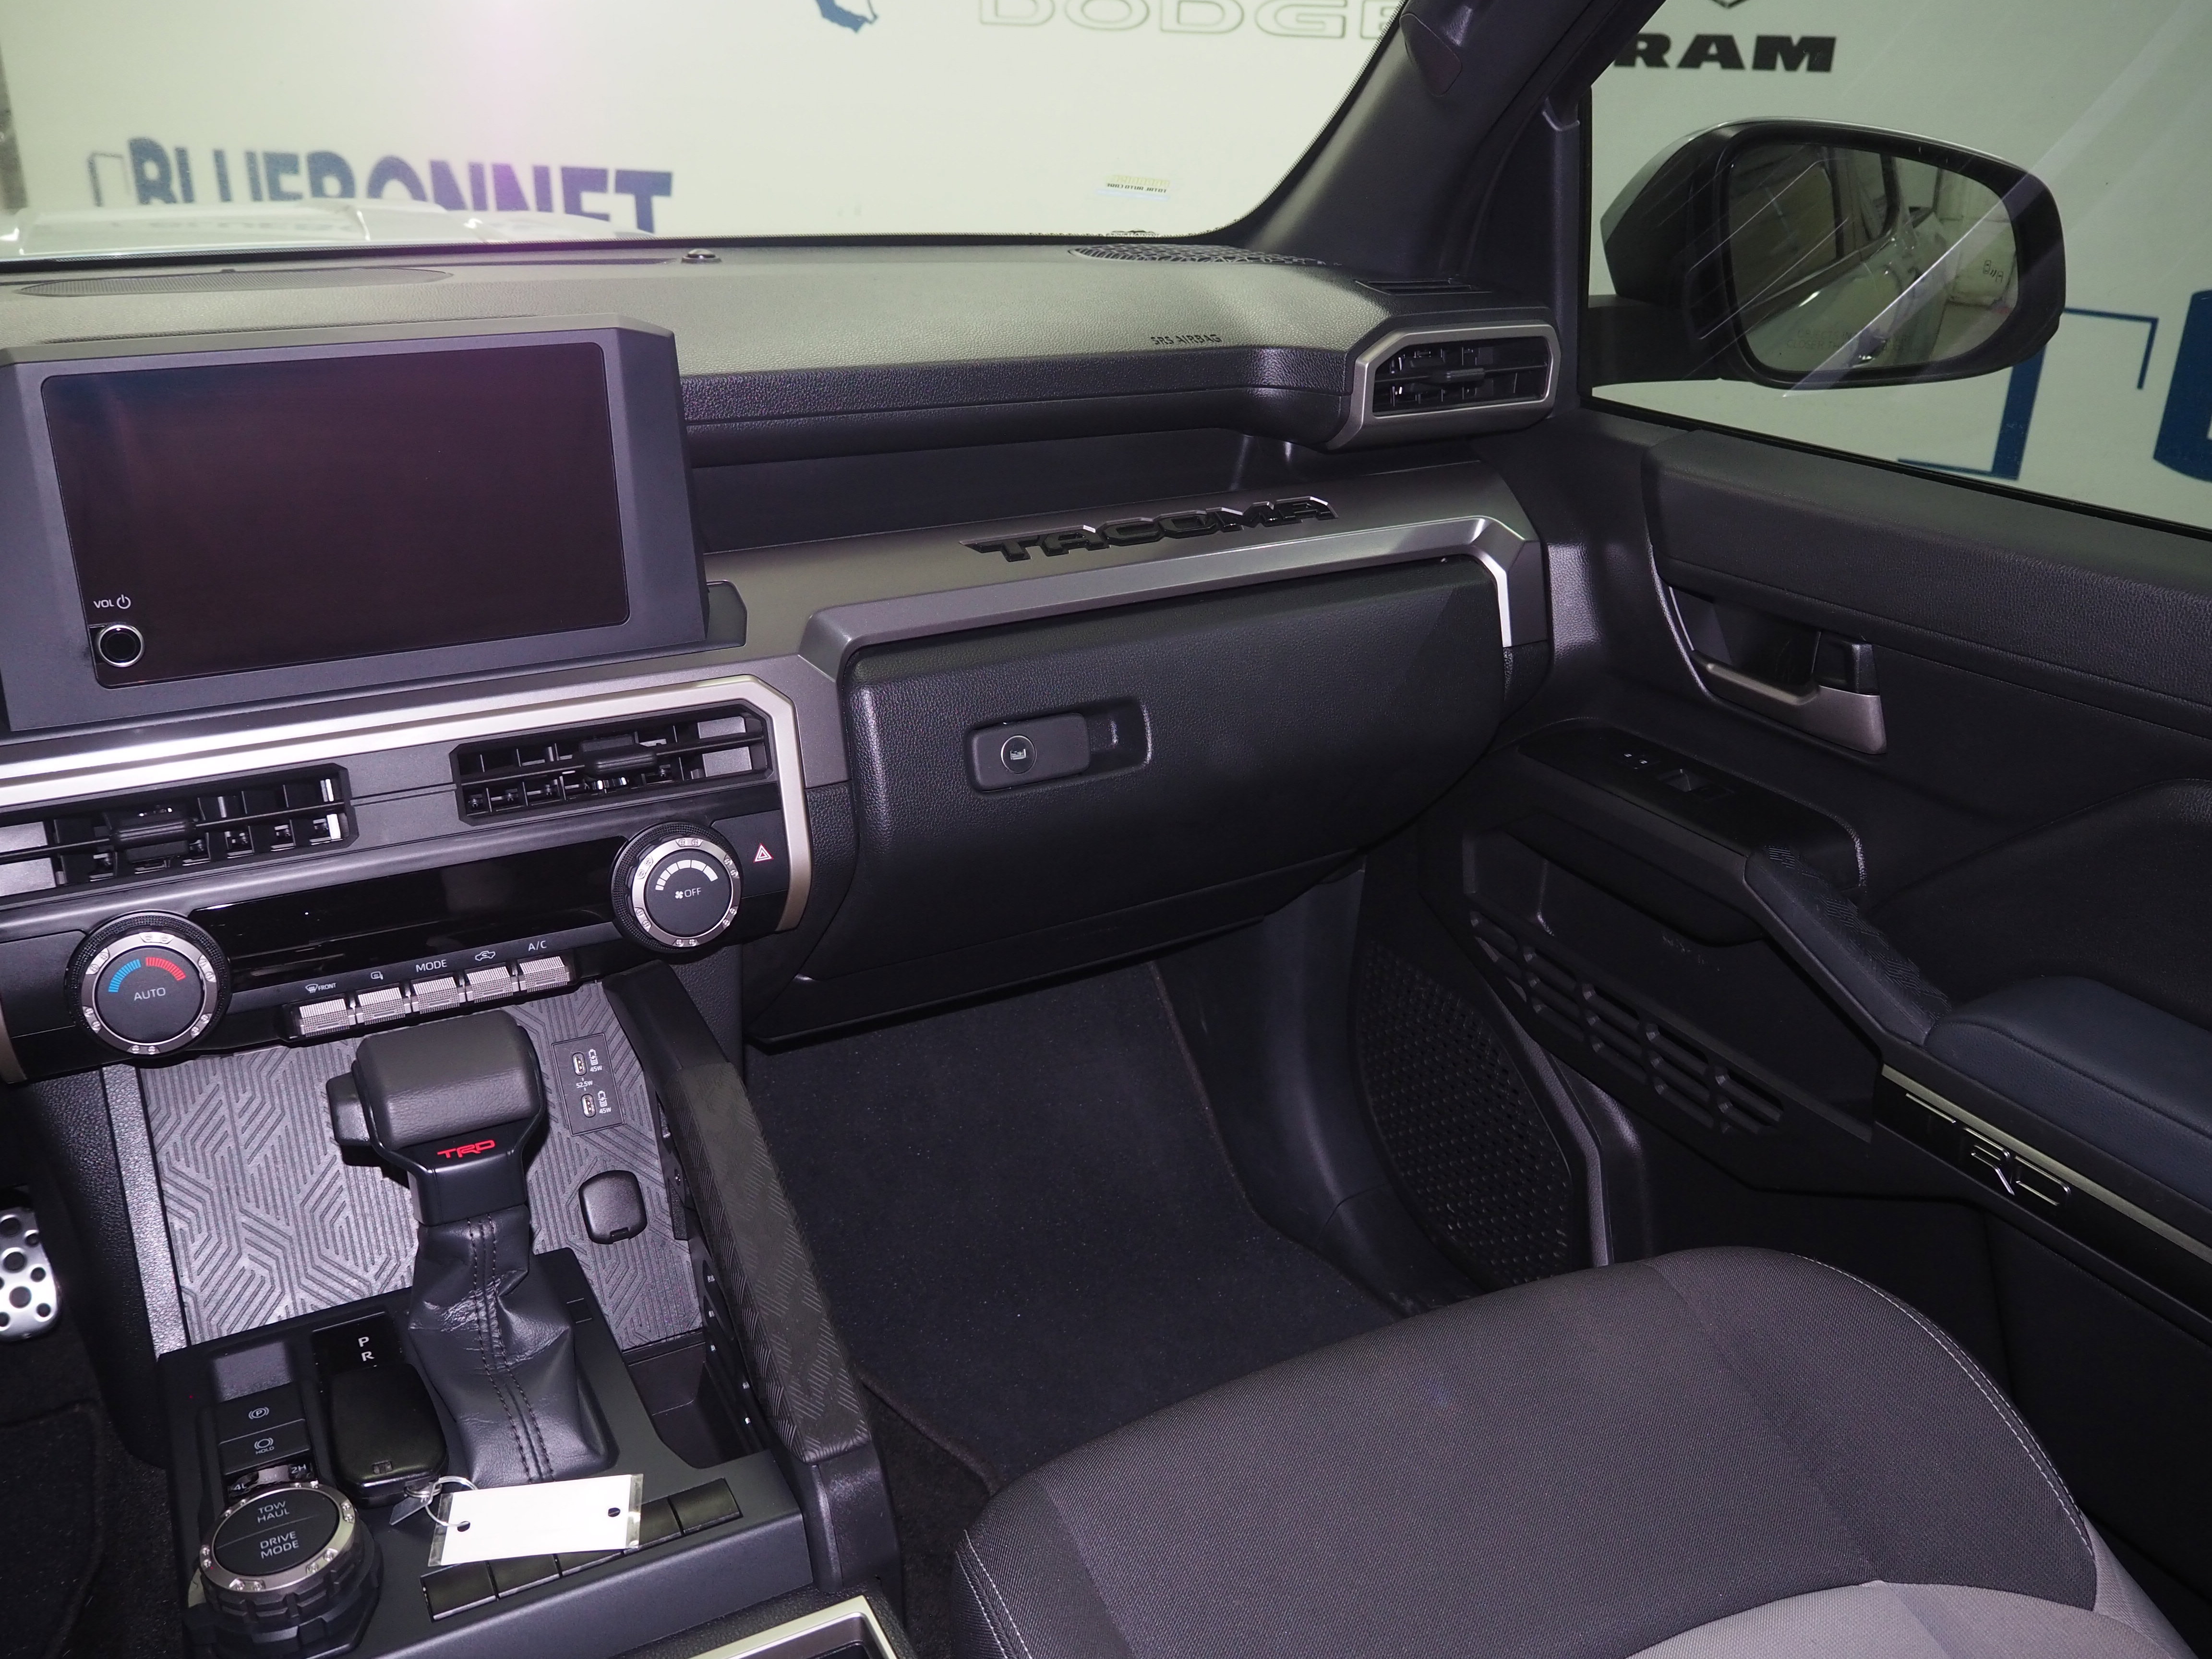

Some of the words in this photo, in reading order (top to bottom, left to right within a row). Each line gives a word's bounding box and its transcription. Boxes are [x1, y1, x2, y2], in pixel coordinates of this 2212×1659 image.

[1614, 33, 1837, 72] RAM
[1151, 336, 1175, 345] SRS
[1176, 334, 1223, 344] AIRBAG
[959, 496, 1338, 563] TACOMA
[94, 599, 115, 609] VOL
[684, 887, 702, 898] OFF
[529, 940, 547, 951] A/C
[416, 959, 447, 973] MODE
[318, 982, 337, 991] FRONT
[134, 987, 166, 1001] AUTO
[437, 1139, 496, 1158] TRD
[358, 1336, 370, 1347] P
[361, 1350, 375, 1362] R
[255, 1446, 275, 1455] HOLD
[291, 1464, 307, 1474] 2H
[258, 1501, 286, 1514] TOW
[257, 1508, 290, 1523] HAUL
[260, 1530, 297, 1550] DRIVE
[260, 1541, 300, 1560] MODE
